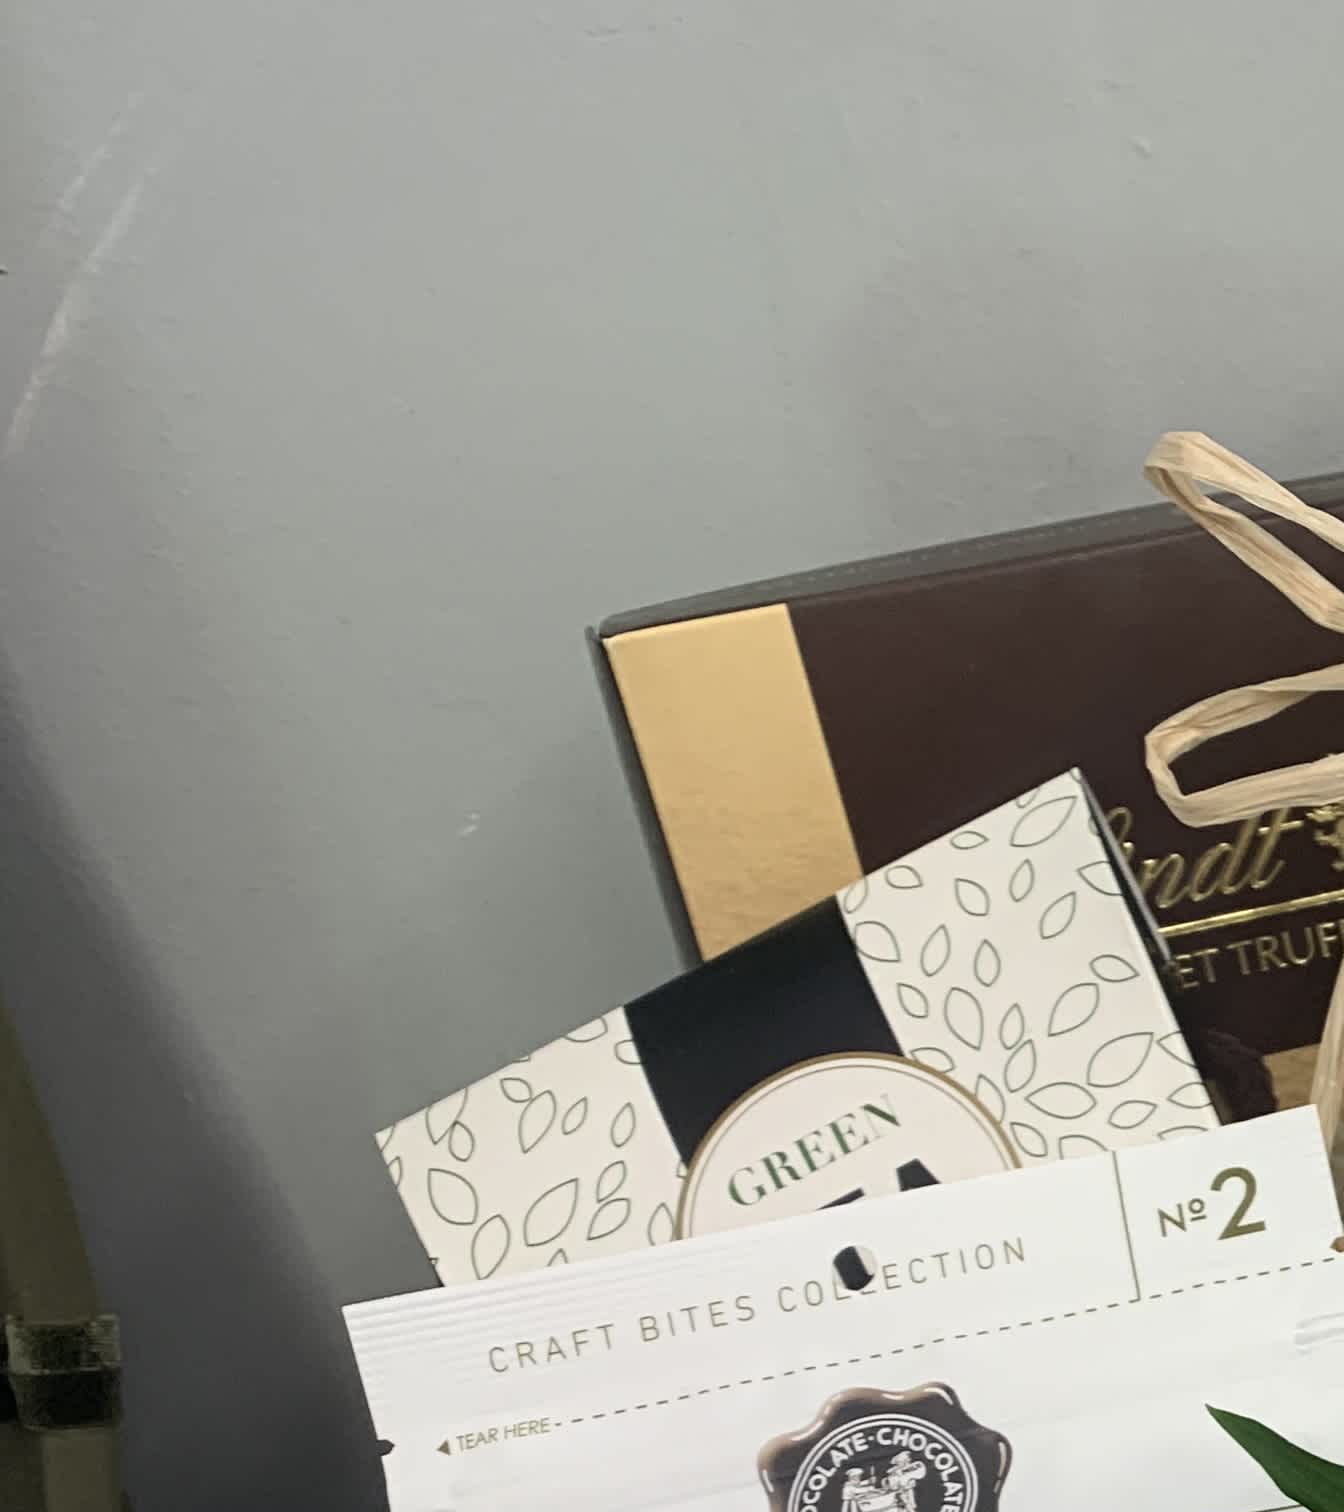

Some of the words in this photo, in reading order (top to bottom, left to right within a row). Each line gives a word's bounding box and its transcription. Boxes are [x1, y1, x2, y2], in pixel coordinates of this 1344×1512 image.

[727, 1092, 904, 1208] GREEN
[488, 1322, 618, 1375] CRAFT
[639, 1295, 757, 1344] BITES
[455, 1426, 500, 1453] TEAR
[503, 1416, 552, 1442] HERE
